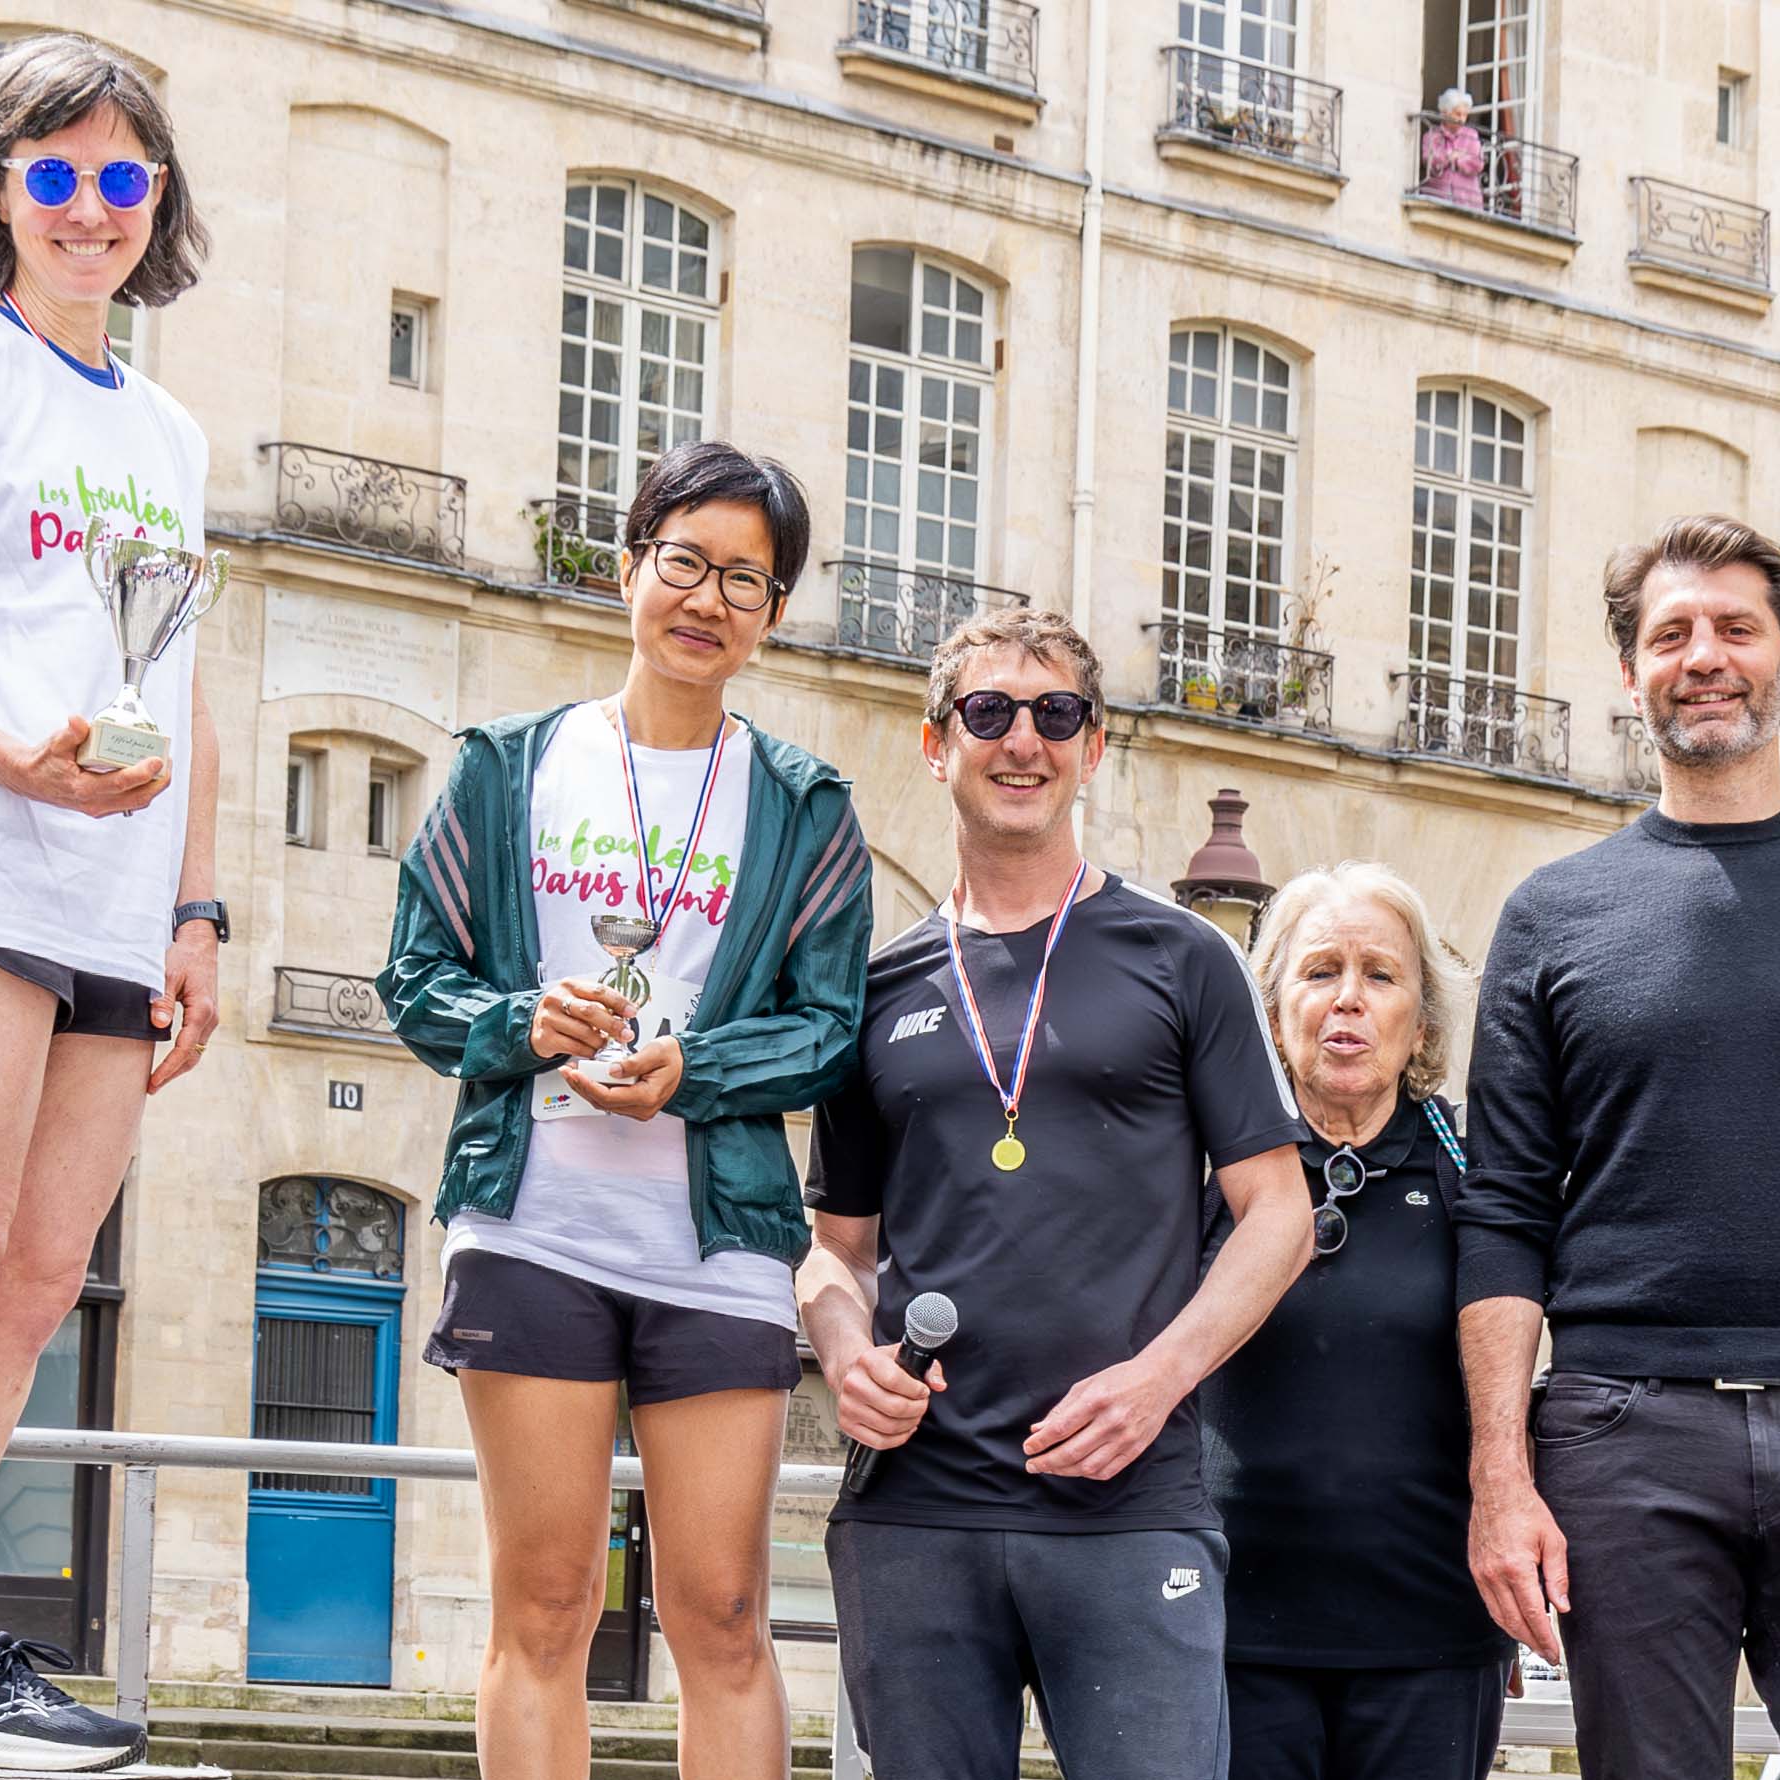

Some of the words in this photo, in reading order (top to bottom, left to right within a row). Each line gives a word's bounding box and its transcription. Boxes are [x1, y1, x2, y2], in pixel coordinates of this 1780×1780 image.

[887, 1005, 948, 1044] NIKE
[334, 1082, 359, 1109] 10
[1169, 1567, 1201, 1587] NIKE
